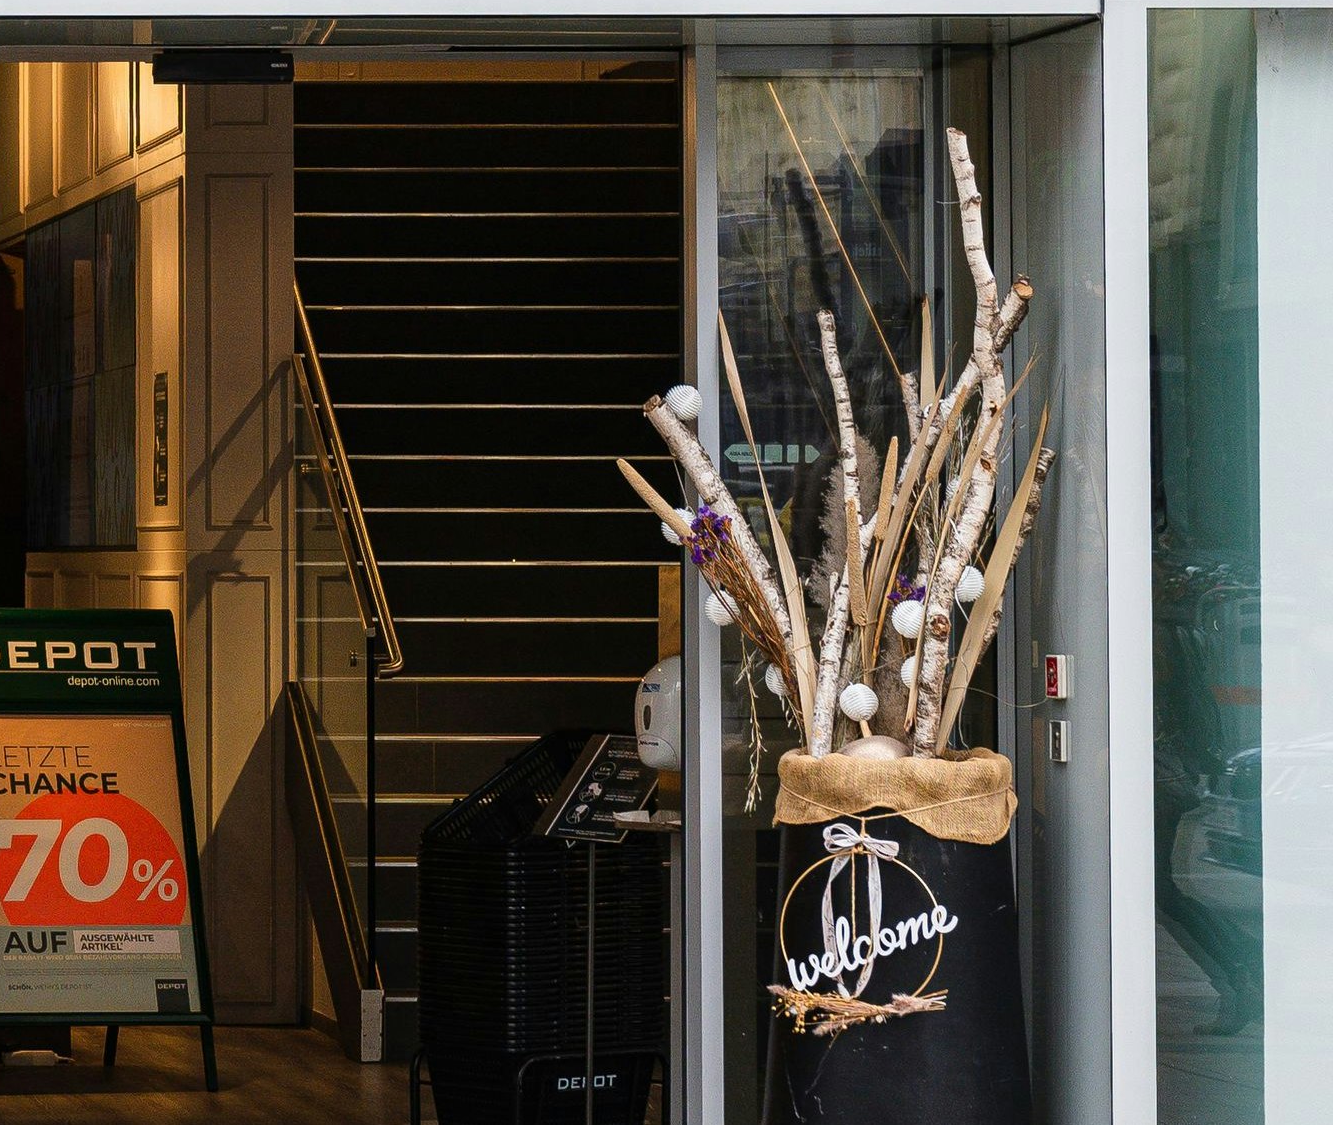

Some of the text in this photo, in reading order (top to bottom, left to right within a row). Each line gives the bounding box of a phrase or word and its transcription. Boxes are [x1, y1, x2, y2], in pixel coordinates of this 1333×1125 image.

[67, 675, 160, 688] depot-online.com
[4, 931, 155, 954] AUF AUSGEWÄHLTE
[788, 905, 959, 991] welcome
